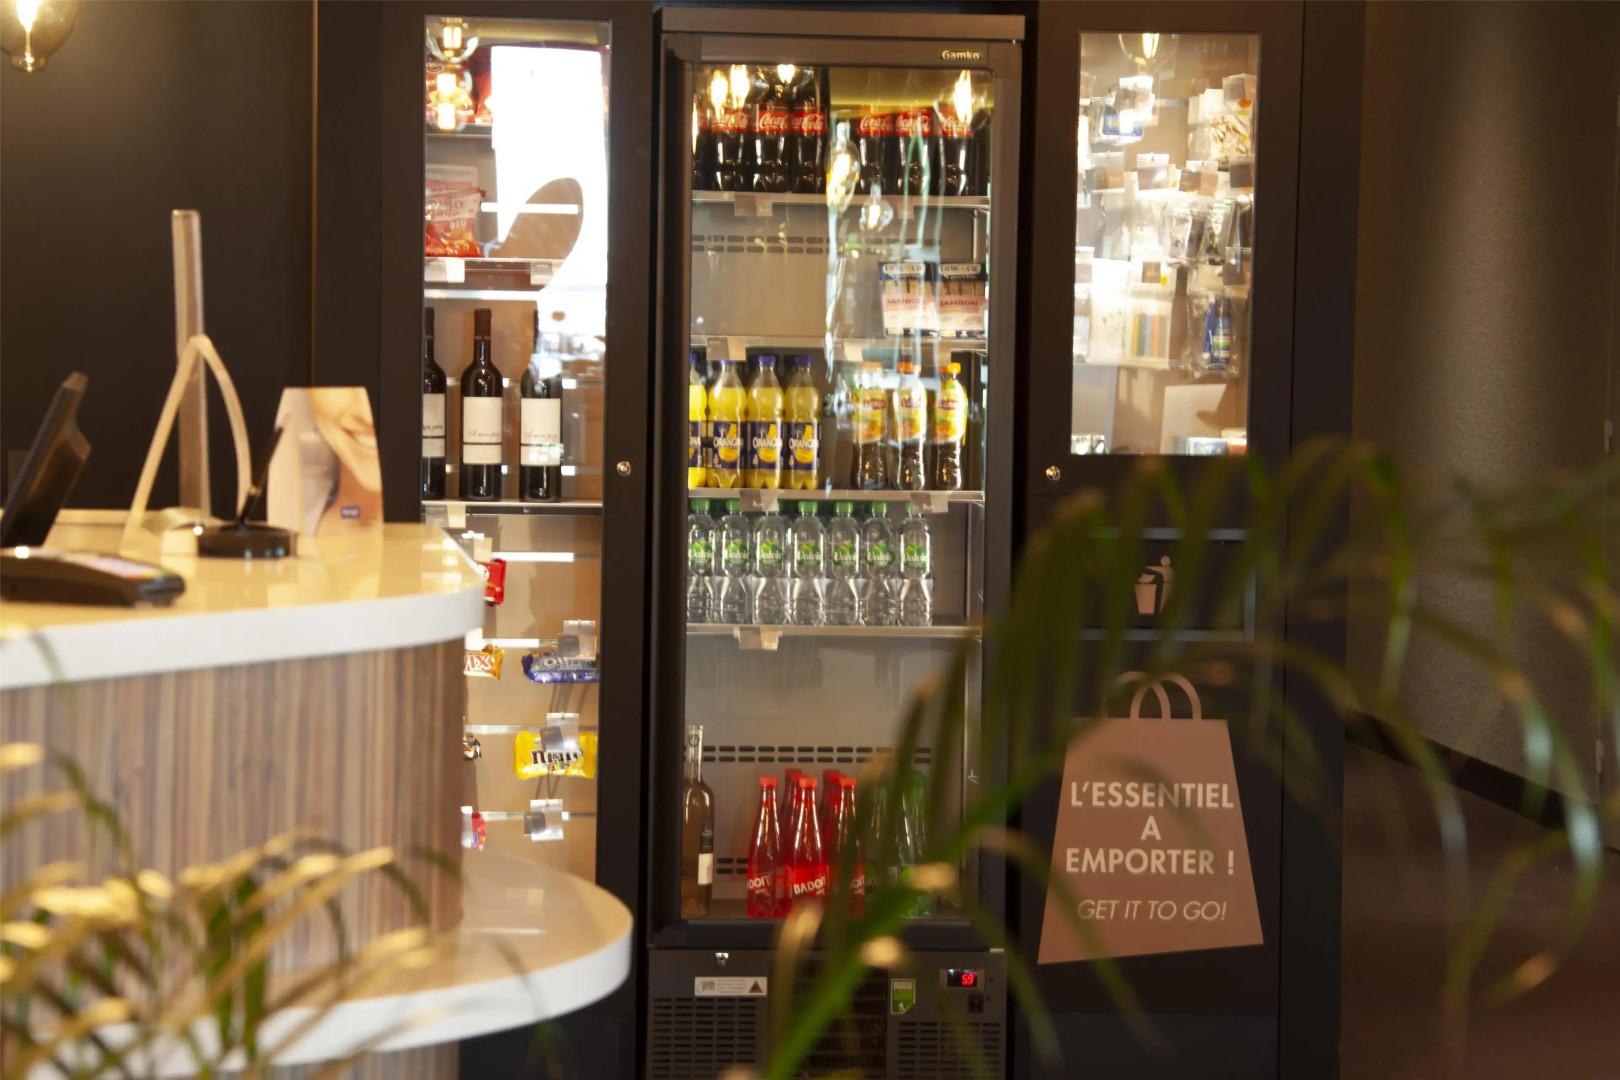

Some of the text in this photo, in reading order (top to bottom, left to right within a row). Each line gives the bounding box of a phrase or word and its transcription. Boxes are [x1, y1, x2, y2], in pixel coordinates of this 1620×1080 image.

[942, 50, 980, 60] Gamko
[939, 299, 978, 307] JAMBON
[1071, 781, 1234, 808] L'ESSENTIEL
[1140, 815, 1162, 841] A
[1066, 848, 1214, 874] EMPORTER
[1077, 899, 1228, 921] GET IT TO GO!
